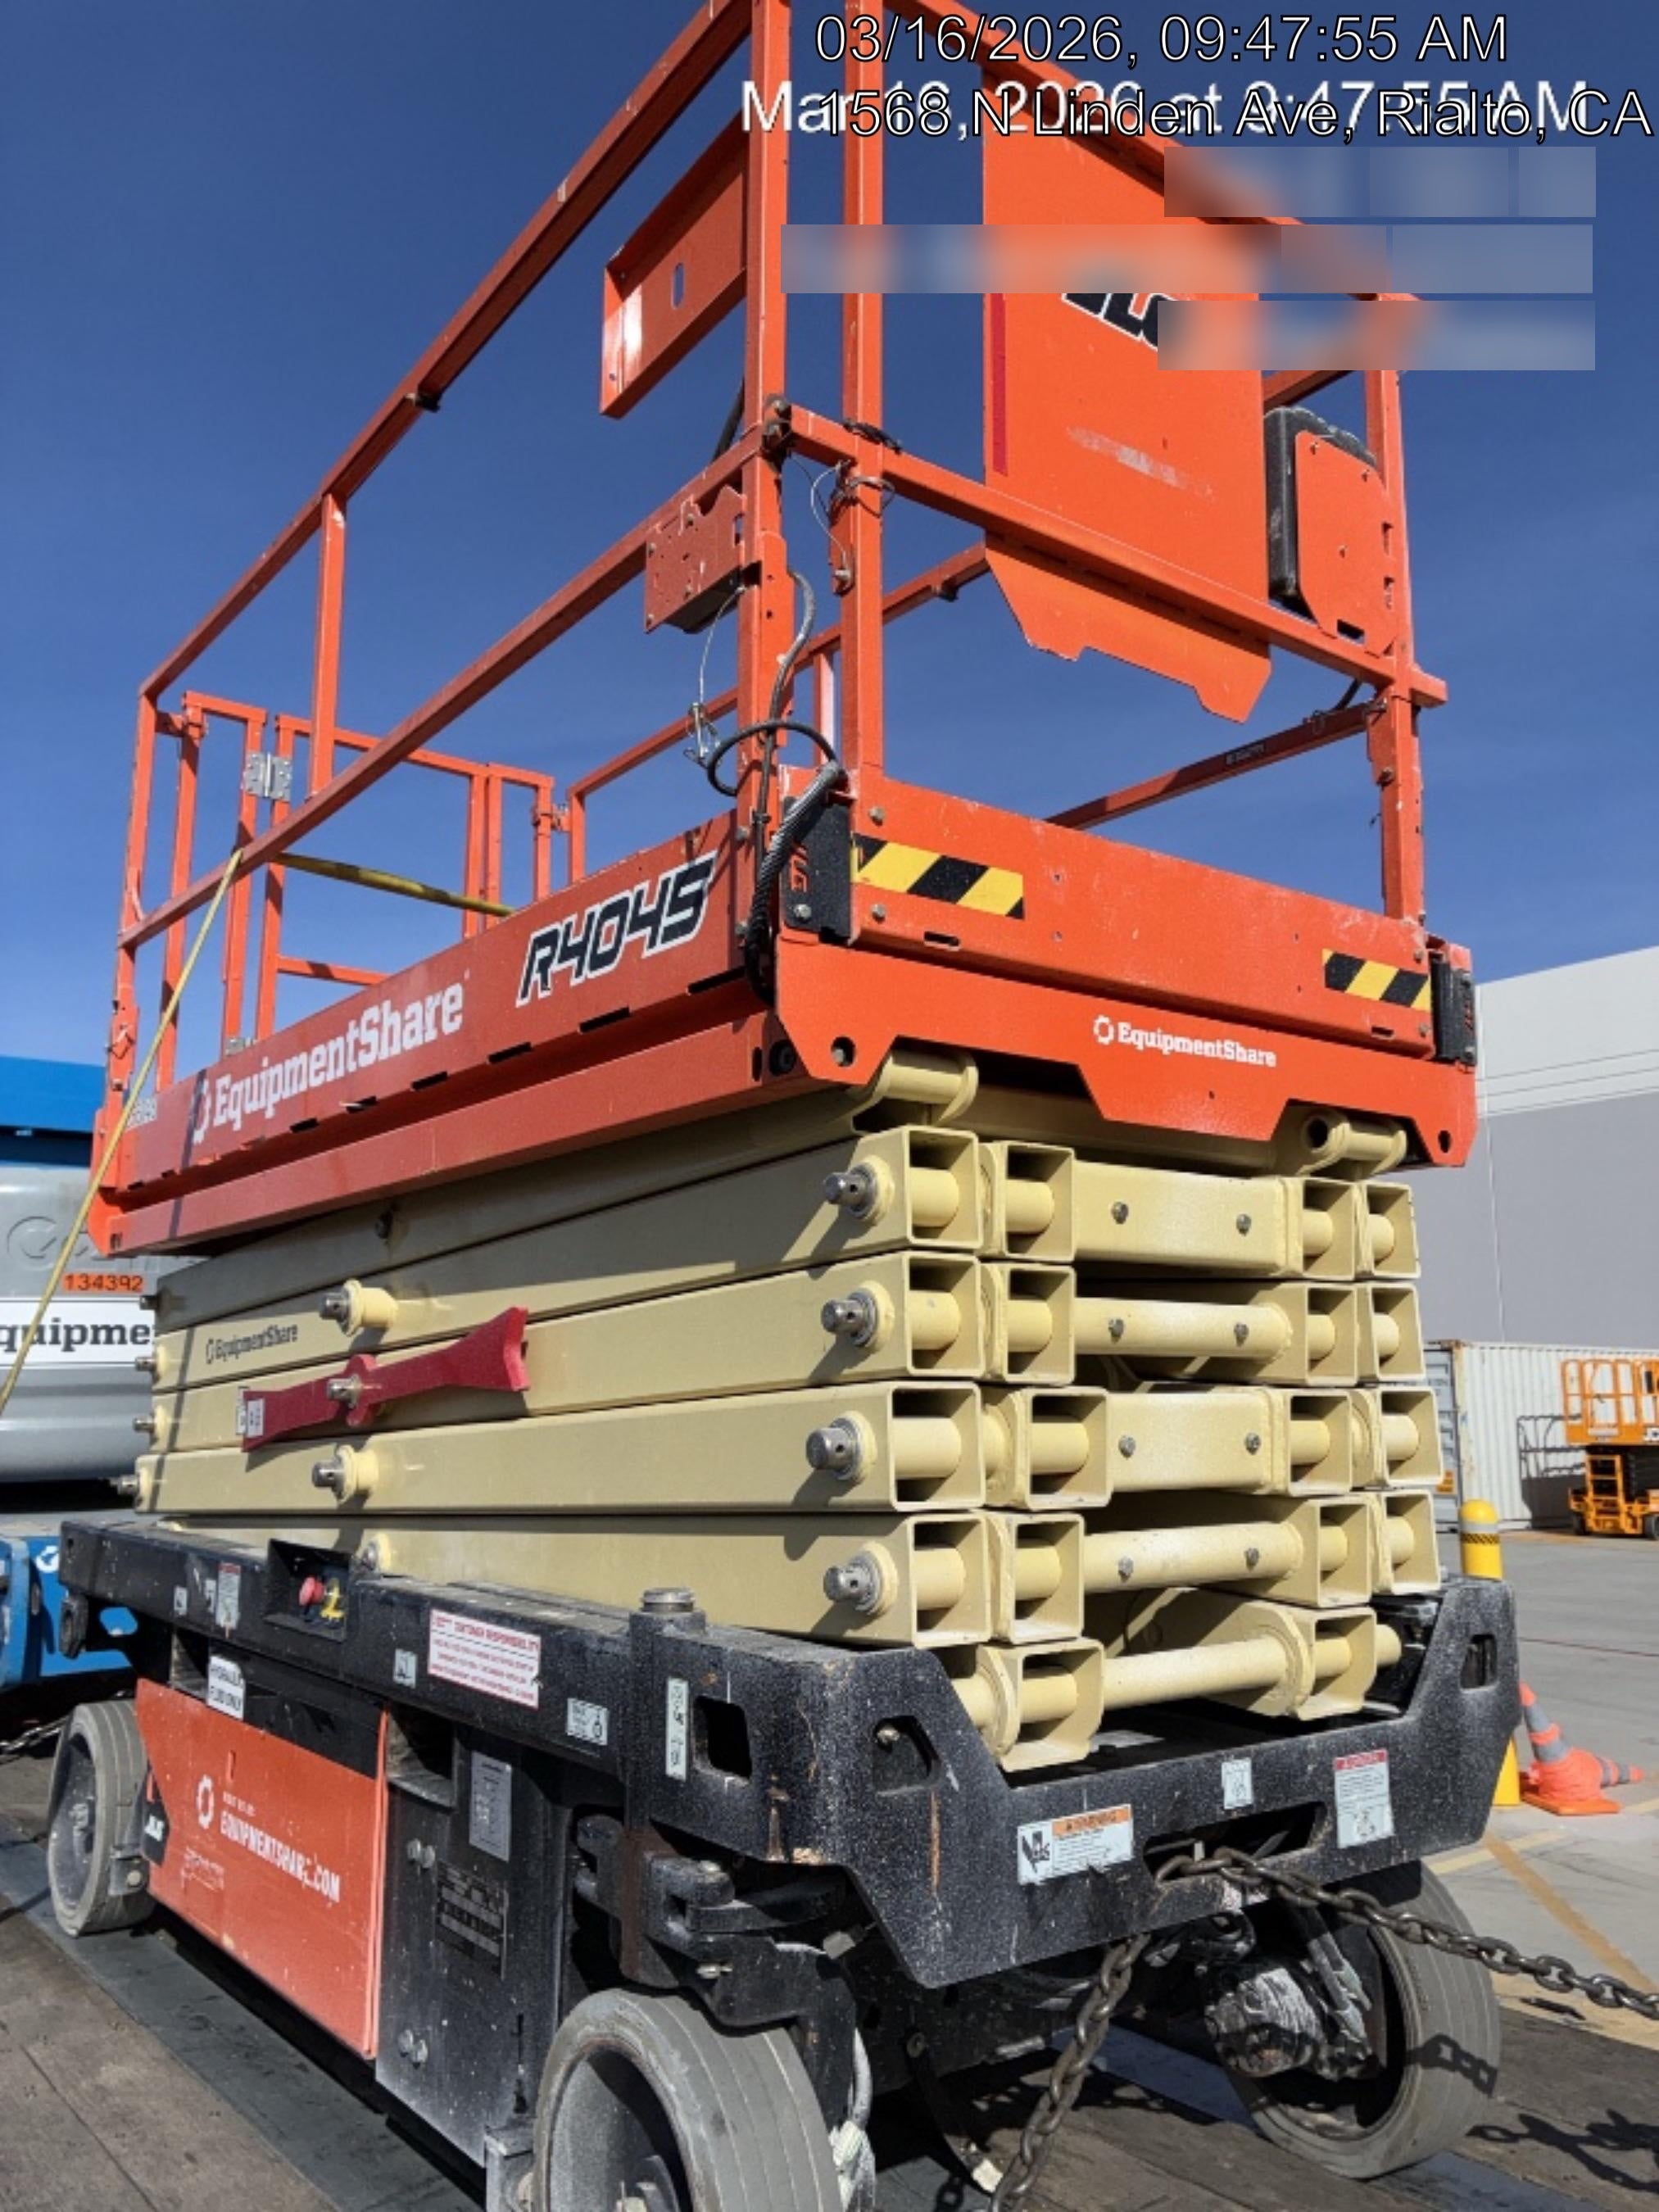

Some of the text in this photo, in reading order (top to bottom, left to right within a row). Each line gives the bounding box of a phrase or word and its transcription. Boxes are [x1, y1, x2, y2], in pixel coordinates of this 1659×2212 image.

[516, 849, 718, 1008] R4045
[212, 981, 464, 1131] EquipmentShare
[1117, 1021, 1277, 1067] EquipmentShare
[65, 1274, 143, 1291] 134392
[0, 1317, 155, 1353] quipme
